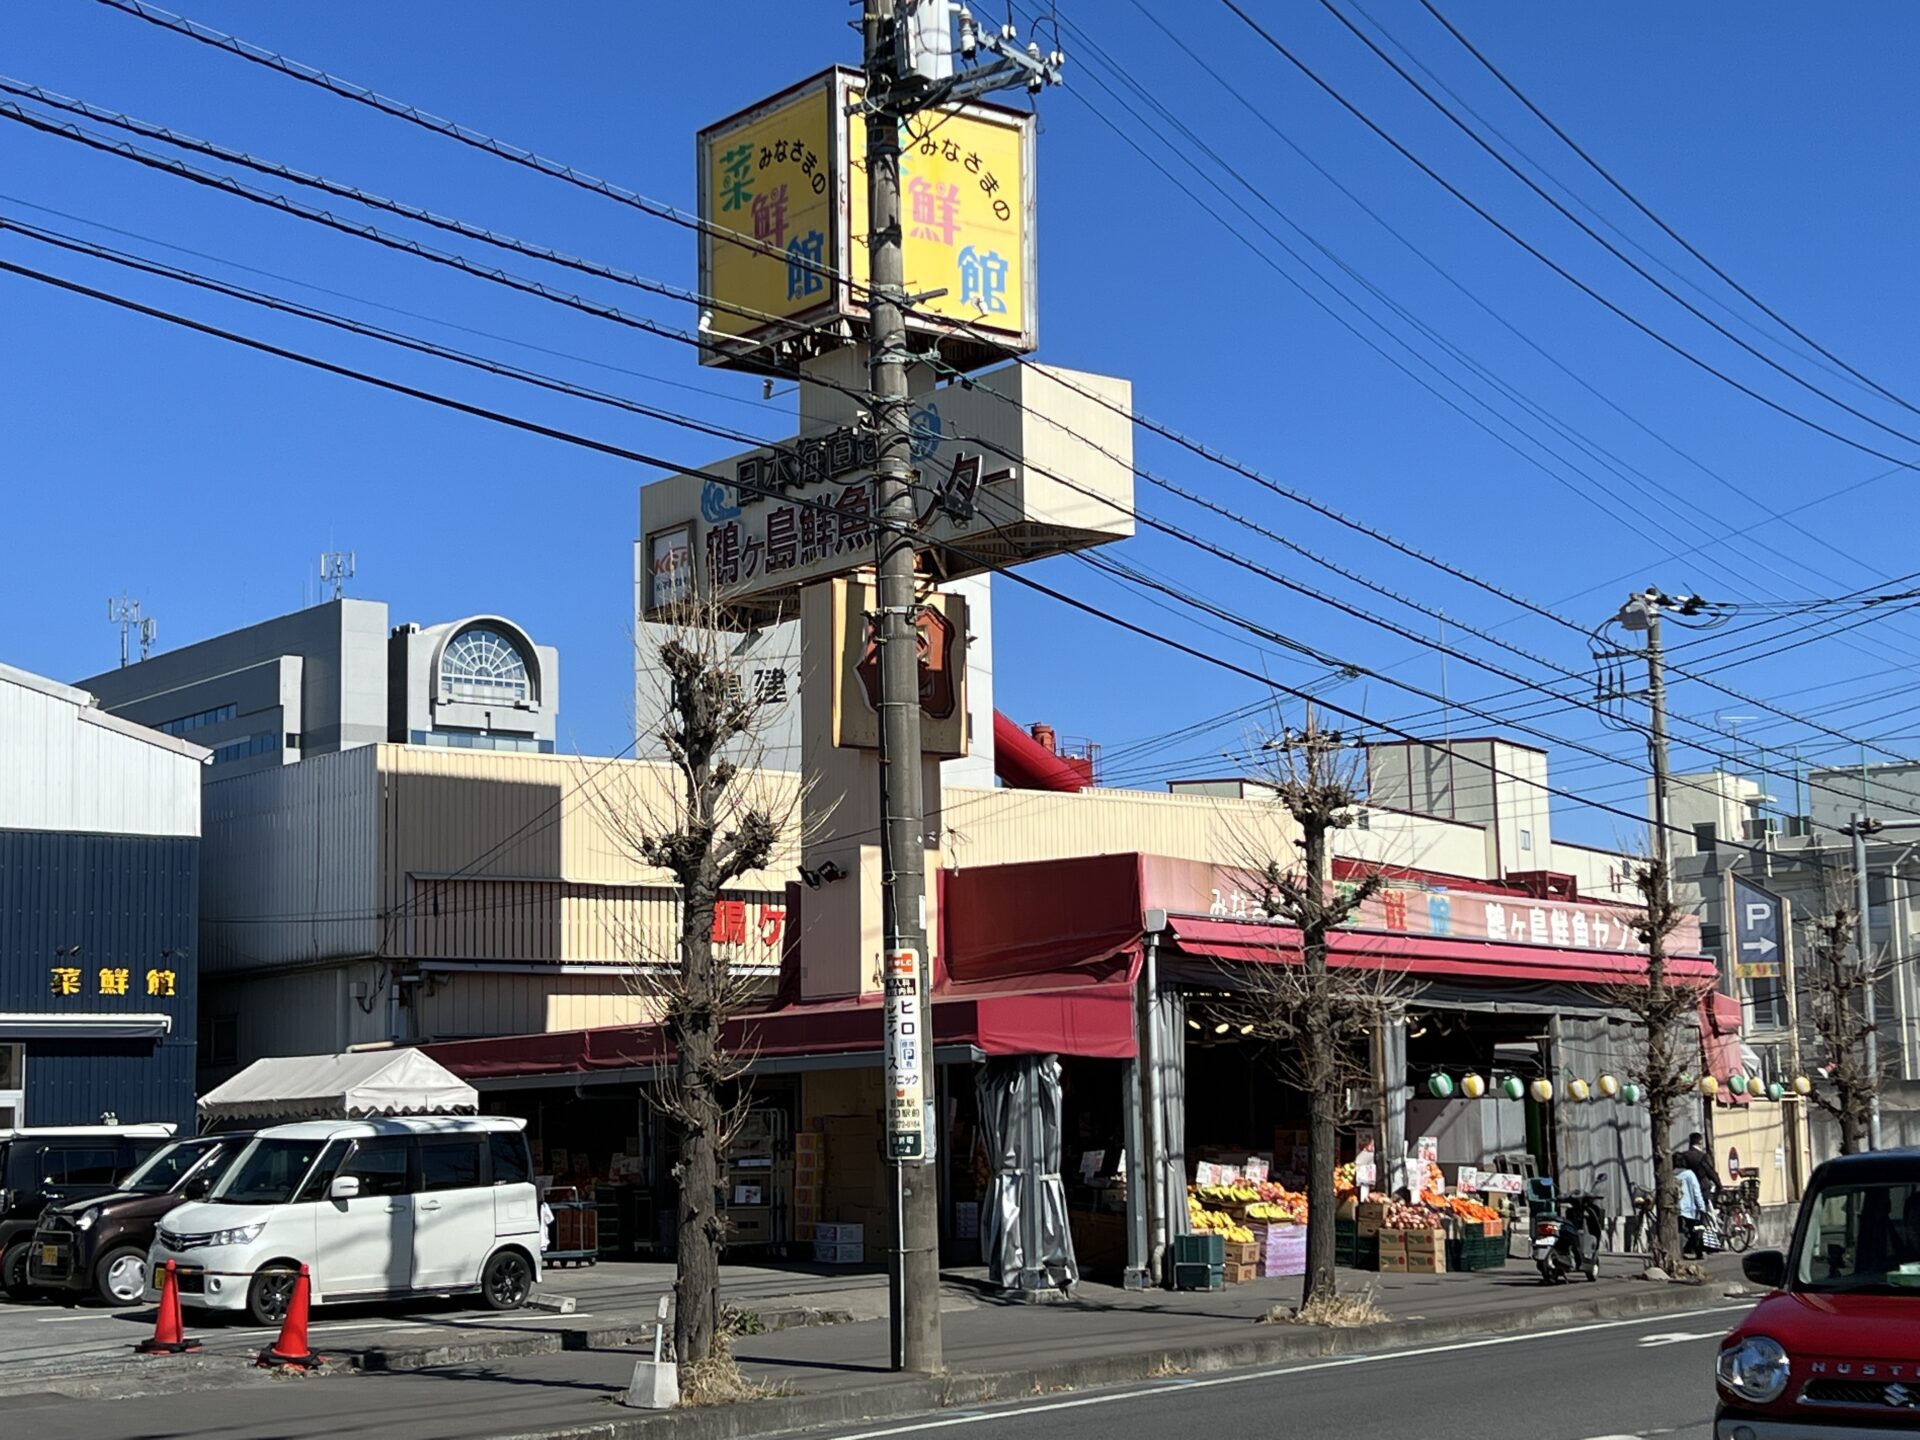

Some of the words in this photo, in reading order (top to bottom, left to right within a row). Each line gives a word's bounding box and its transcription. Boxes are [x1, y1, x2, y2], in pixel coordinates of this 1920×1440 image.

[758, 138, 826, 196] みなさまの
[919, 136, 1012, 222] みなさまの
[718, 143, 825, 302] 菜鮮館
[705, 450, 1016, 588] 鶴ヶ島鮮魚ンター
[1746, 903, 1771, 930] P
[51, 967, 176, 996] 菜鮮館
[887, 1075, 919, 1086] クリニック
